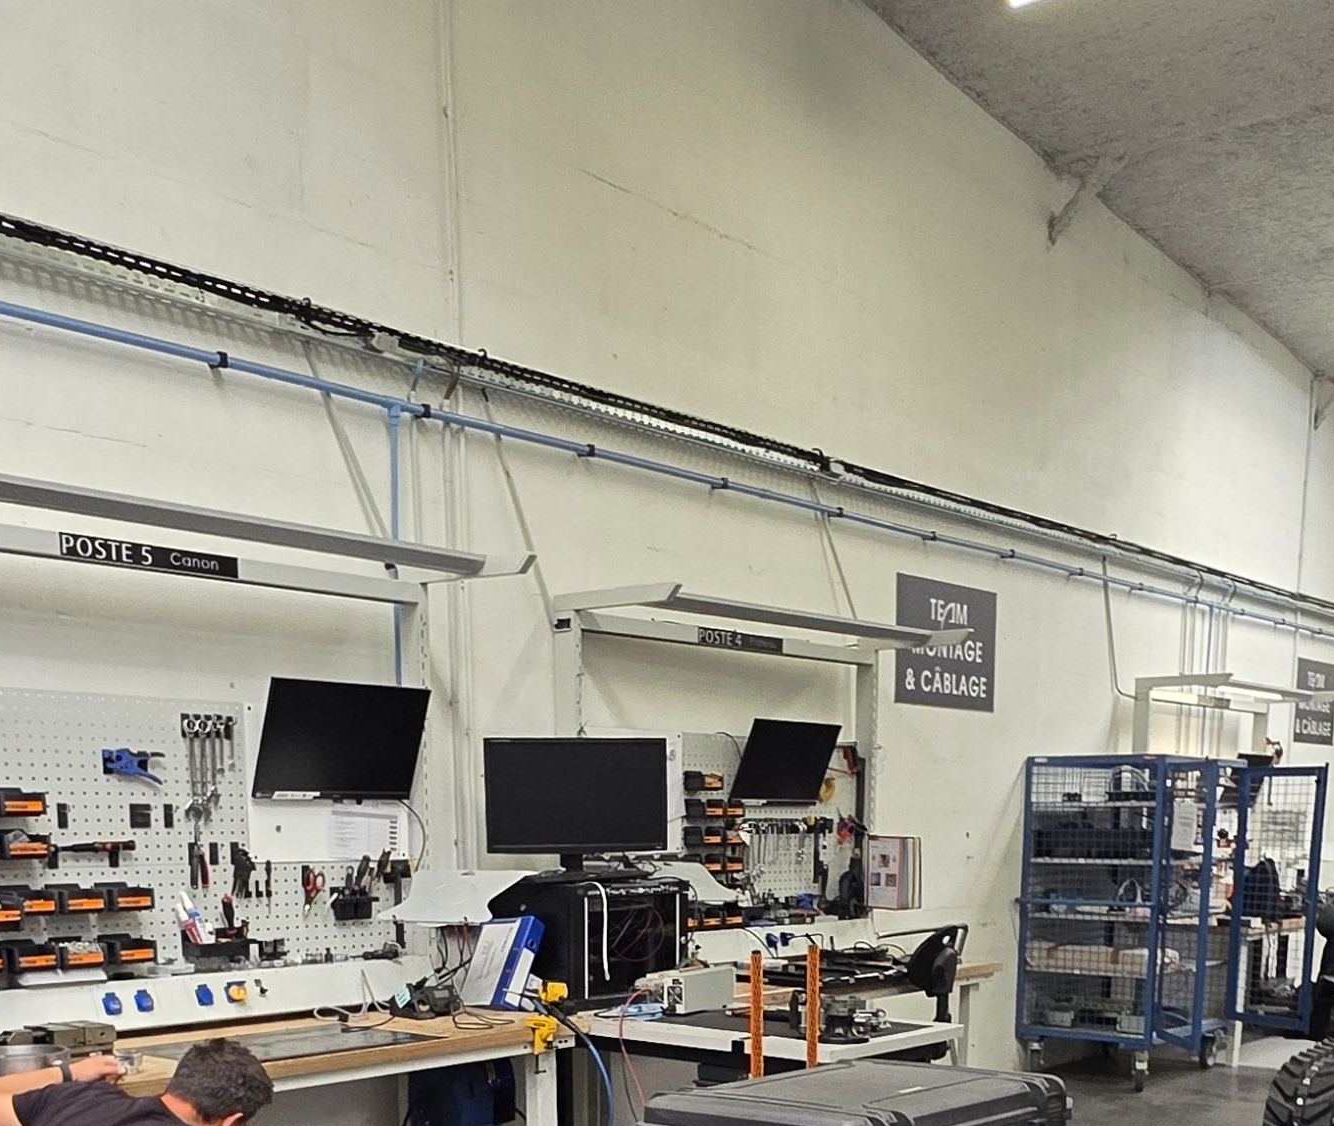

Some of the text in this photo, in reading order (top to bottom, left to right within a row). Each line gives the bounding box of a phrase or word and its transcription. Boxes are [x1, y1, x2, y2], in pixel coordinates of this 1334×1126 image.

[61, 533, 219, 571] POSTE 5 Canon
[930, 598, 967, 629] TEAM
[699, 628, 733, 646] POSTE
[735, 633, 742, 647] 4
[905, 666, 987, 698] & CÂBLAGE
